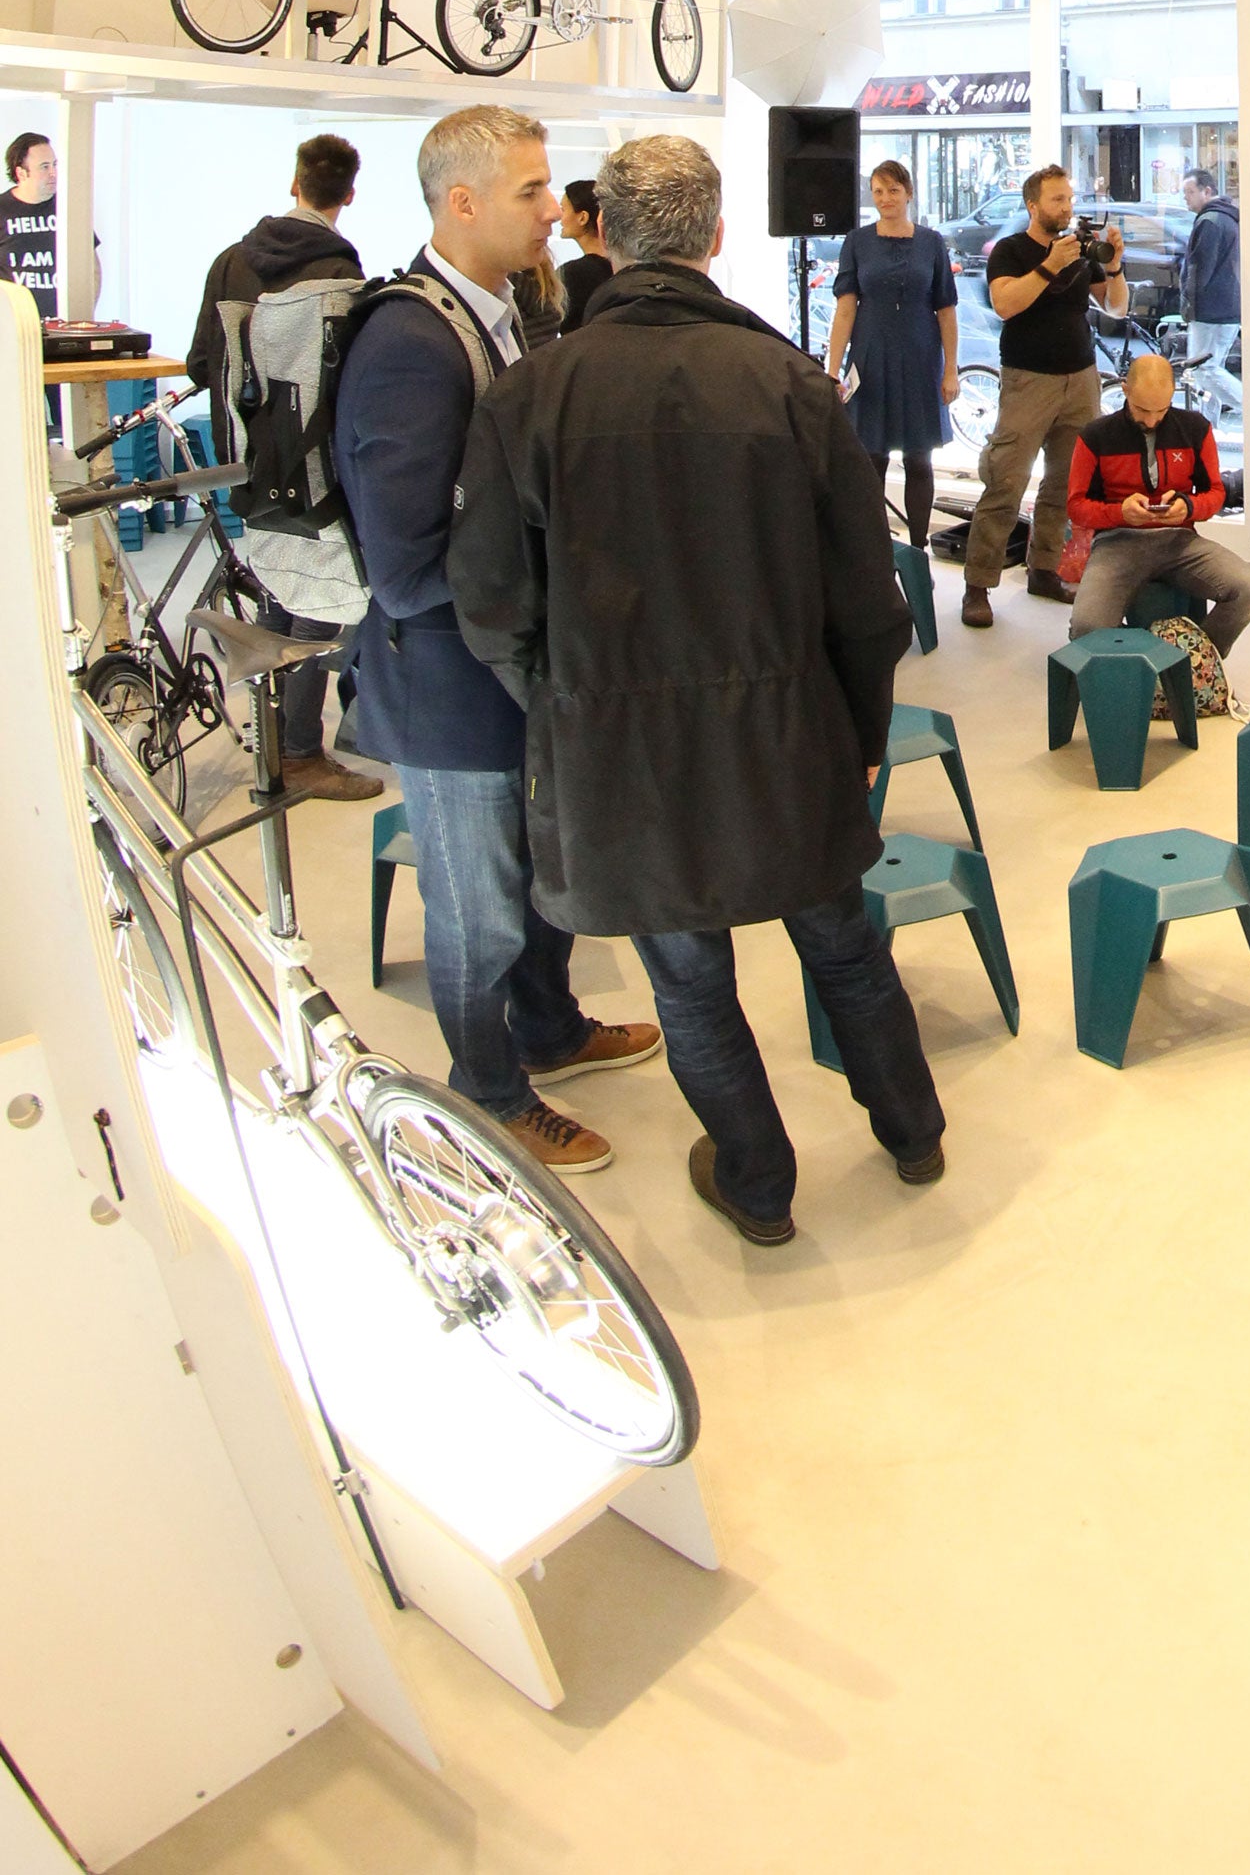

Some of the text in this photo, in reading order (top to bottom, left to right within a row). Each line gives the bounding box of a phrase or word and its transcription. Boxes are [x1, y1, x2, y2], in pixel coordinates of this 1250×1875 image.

[861, 83, 926, 110] WILD
[7, 215, 57, 235] HELLO
[9, 251, 54, 267] I AM
